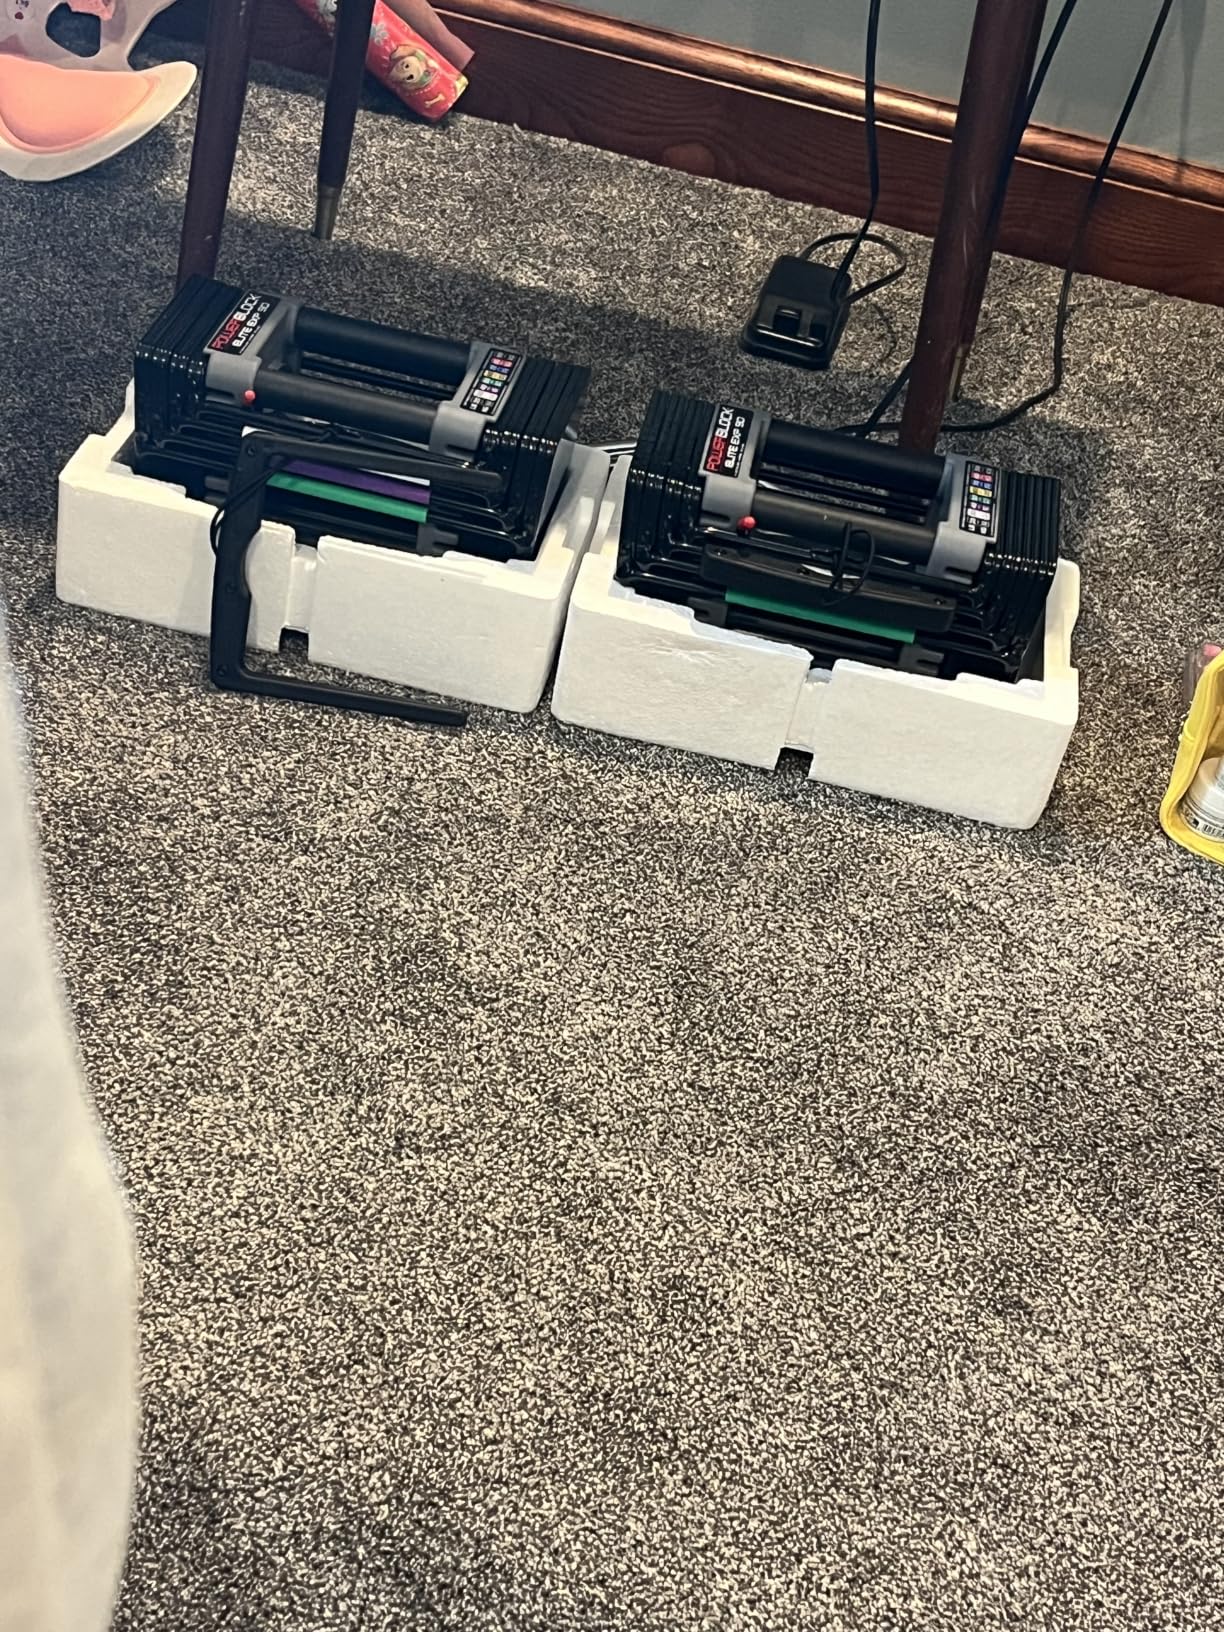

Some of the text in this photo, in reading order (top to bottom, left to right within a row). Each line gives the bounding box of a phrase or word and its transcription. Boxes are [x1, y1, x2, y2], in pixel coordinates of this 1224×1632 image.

[232, 326, 253, 347] ELITE
[247, 312, 261, 327] EXP
[735, 416, 745, 428] 90
[730, 428, 741, 445] EXP
[724, 444, 738, 468] ELITE
